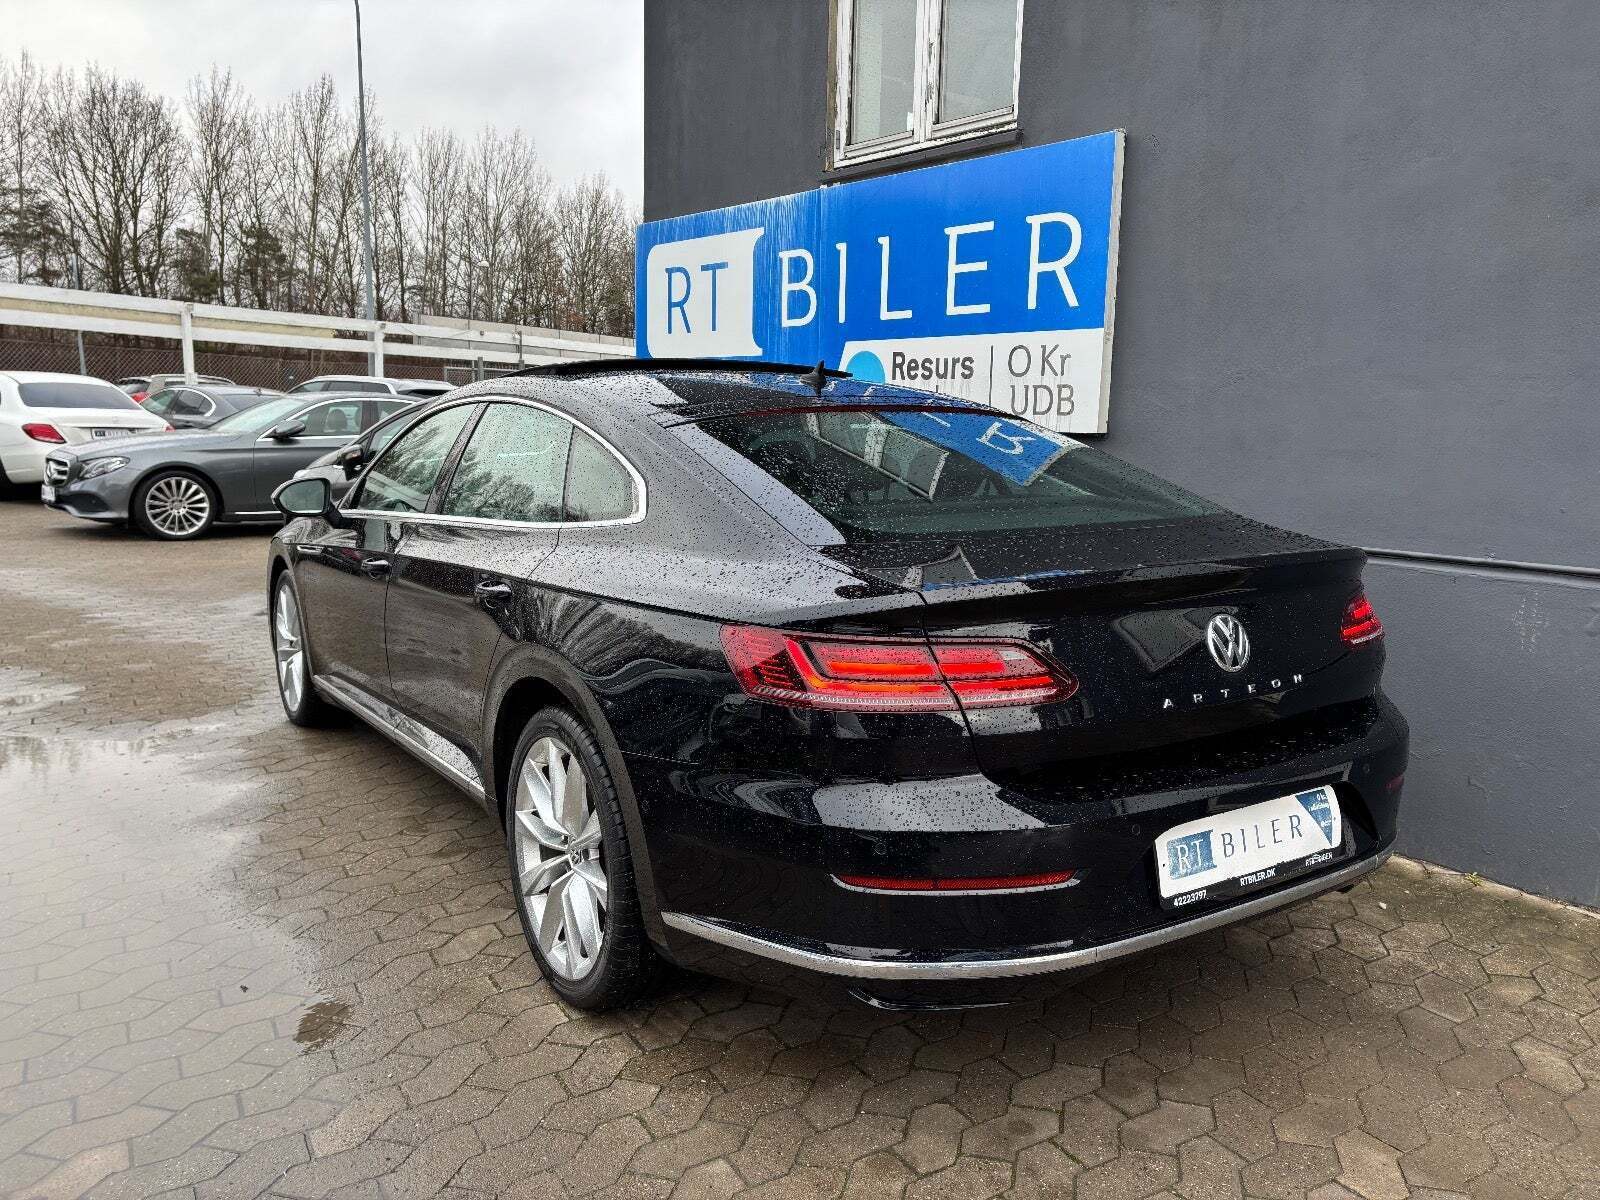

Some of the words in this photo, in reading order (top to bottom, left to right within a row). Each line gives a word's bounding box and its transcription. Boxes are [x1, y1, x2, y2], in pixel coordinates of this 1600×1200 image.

[664, 261, 729, 335] RT
[779, 211, 1083, 328] BILER
[891, 351, 975, 381] Resurs
[1040, 343, 1072, 377] Kr
[1010, 383, 1075, 417] UDB
[1163, 673, 1303, 709] ARTEON
[1175, 838, 1206, 873] RT
[1221, 813, 1303, 859] BILER
